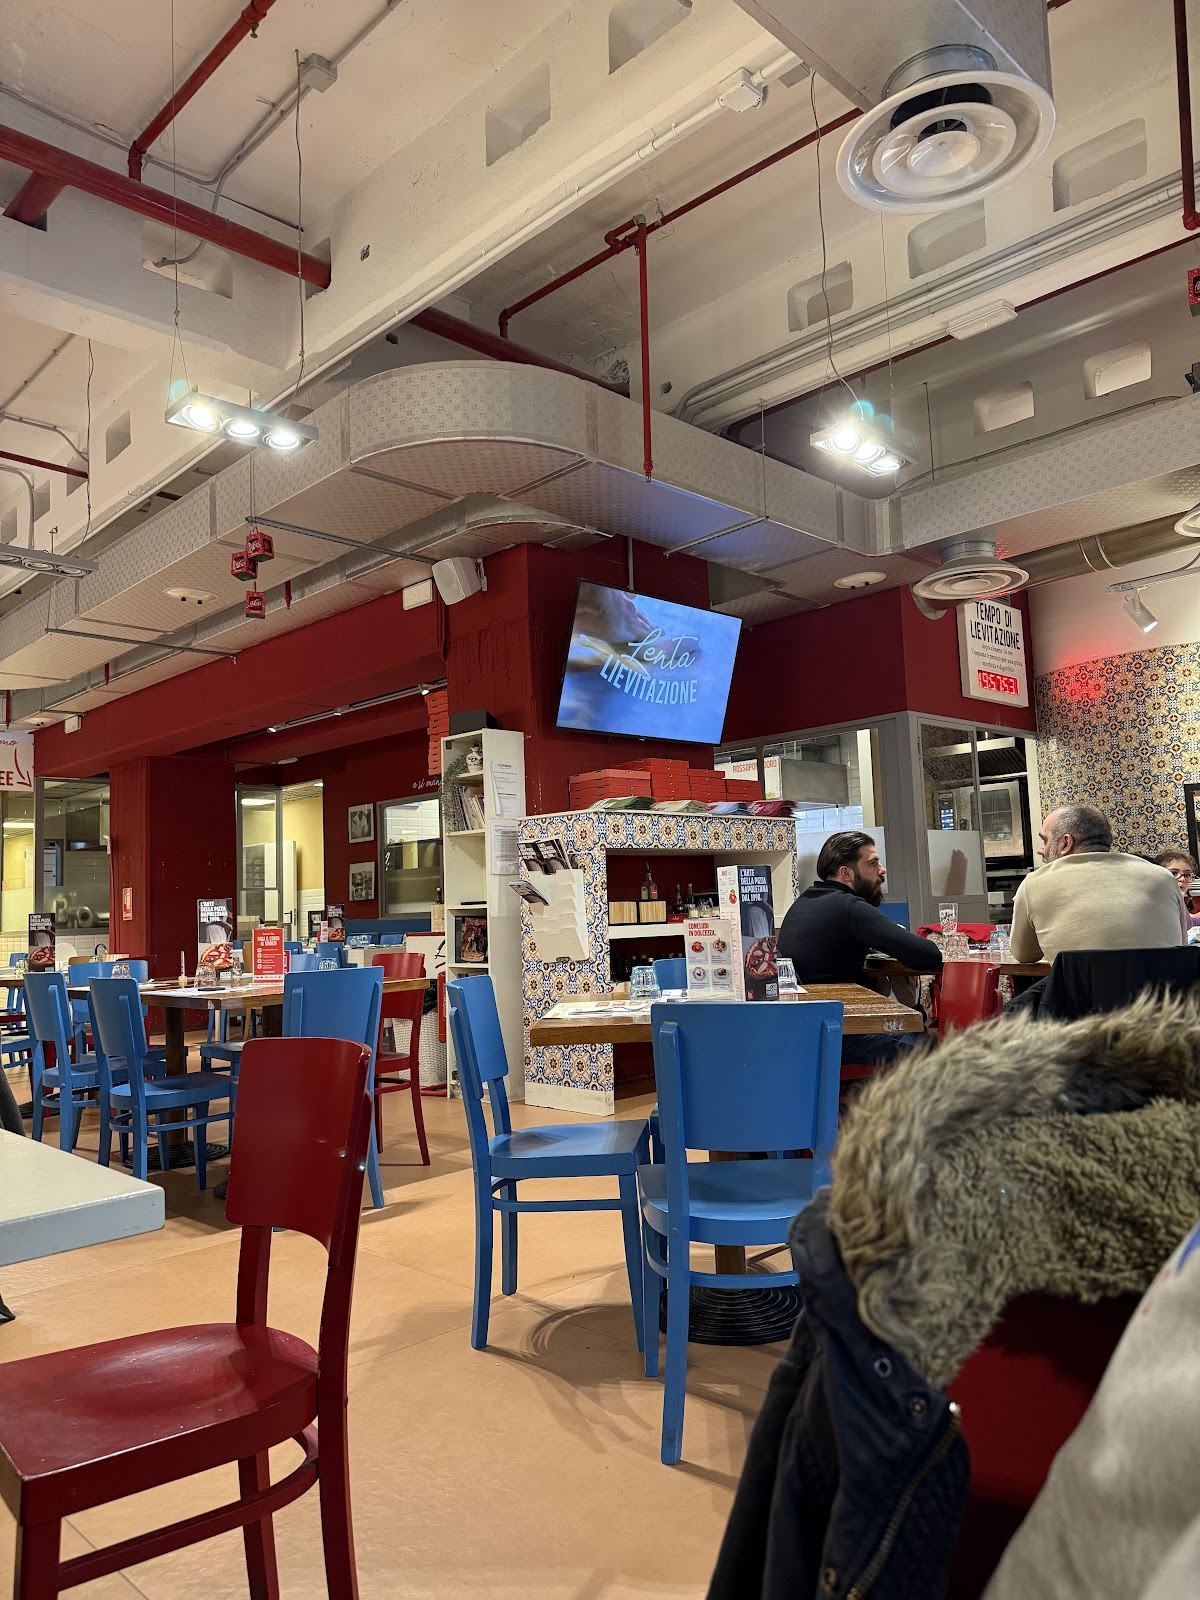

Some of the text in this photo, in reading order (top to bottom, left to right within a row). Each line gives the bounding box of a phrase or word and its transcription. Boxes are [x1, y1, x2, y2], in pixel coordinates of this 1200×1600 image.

[975, 602, 1013, 628] TEMPO DI
[969, 620, 1021, 650] LIEVITAZIONE
[621, 628, 698, 676] Lenta
[600, 653, 698, 705] LIEVITAZIONE
[740, 877, 755, 885] DELLA
[740, 884, 769, 894] NAPOLETANA
[688, 922, 709, 930] CONCLUDI
